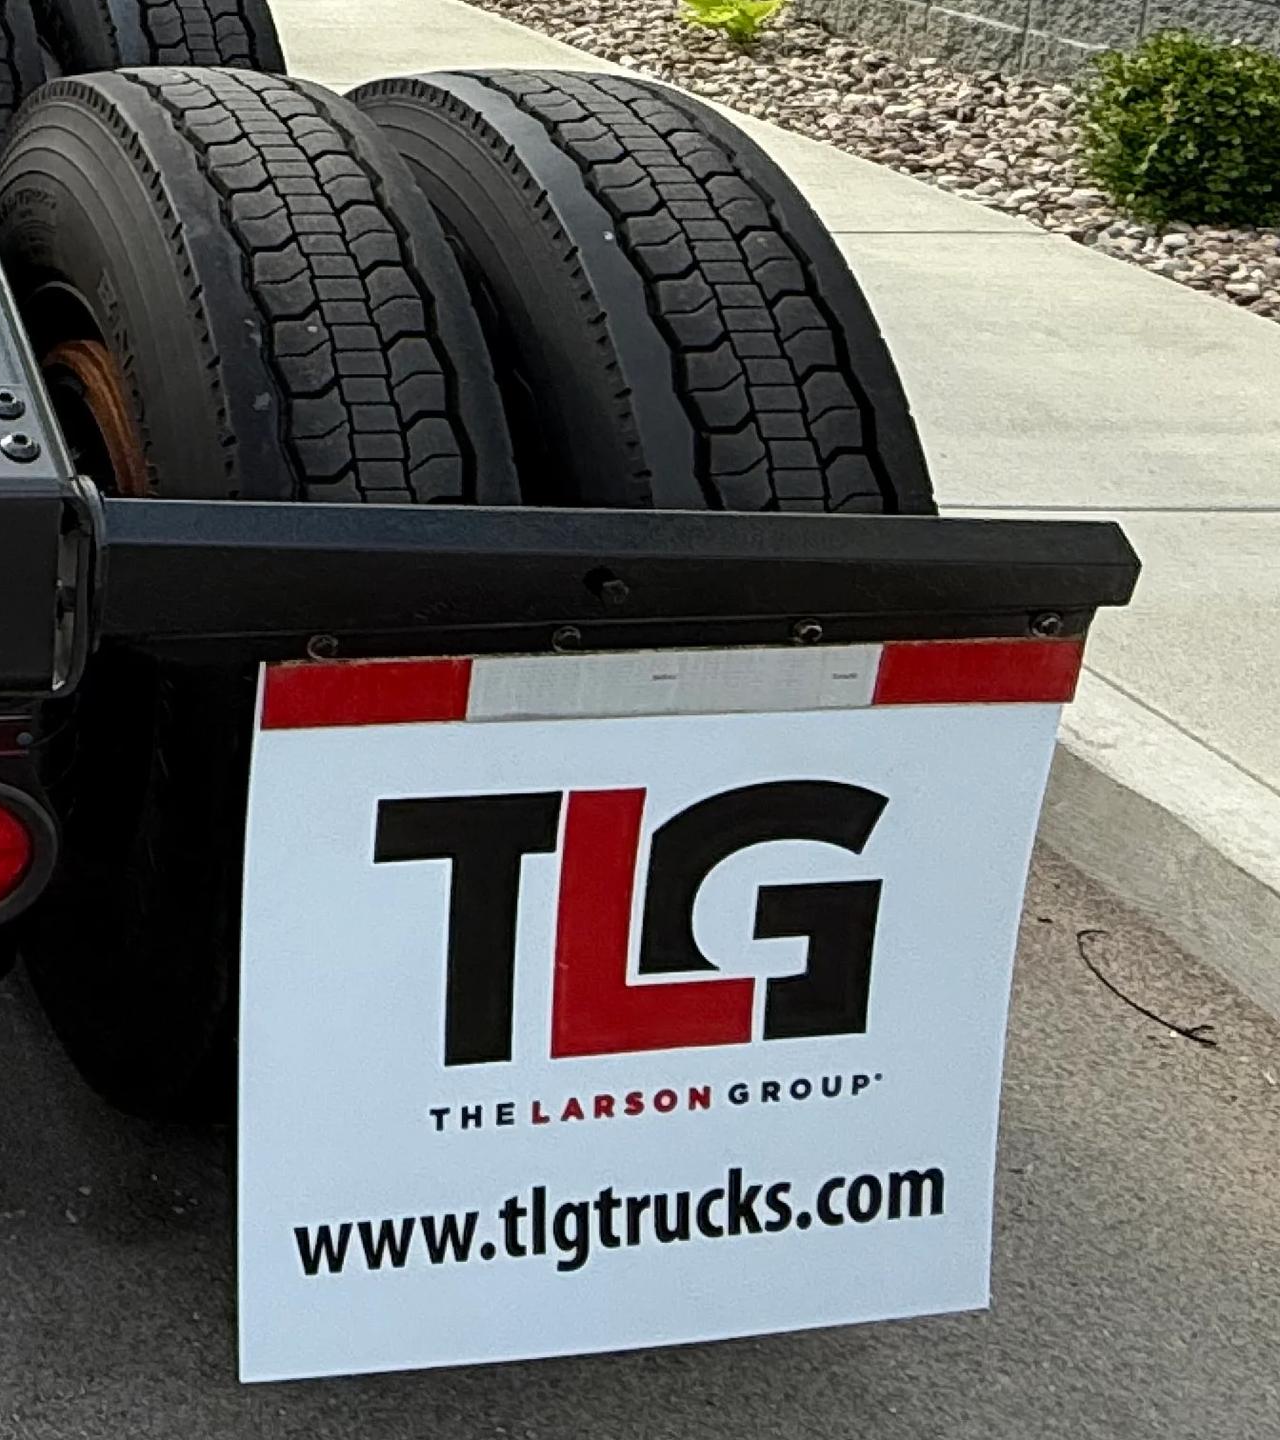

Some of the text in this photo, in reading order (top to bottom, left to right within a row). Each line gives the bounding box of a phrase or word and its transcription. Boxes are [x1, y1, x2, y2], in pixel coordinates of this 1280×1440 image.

[374, 779, 890, 1067] TLG
[429, 1073, 871, 1133] THE LARSON GROUP
[293, 1165, 947, 1277] www.tlgtrucks.com
